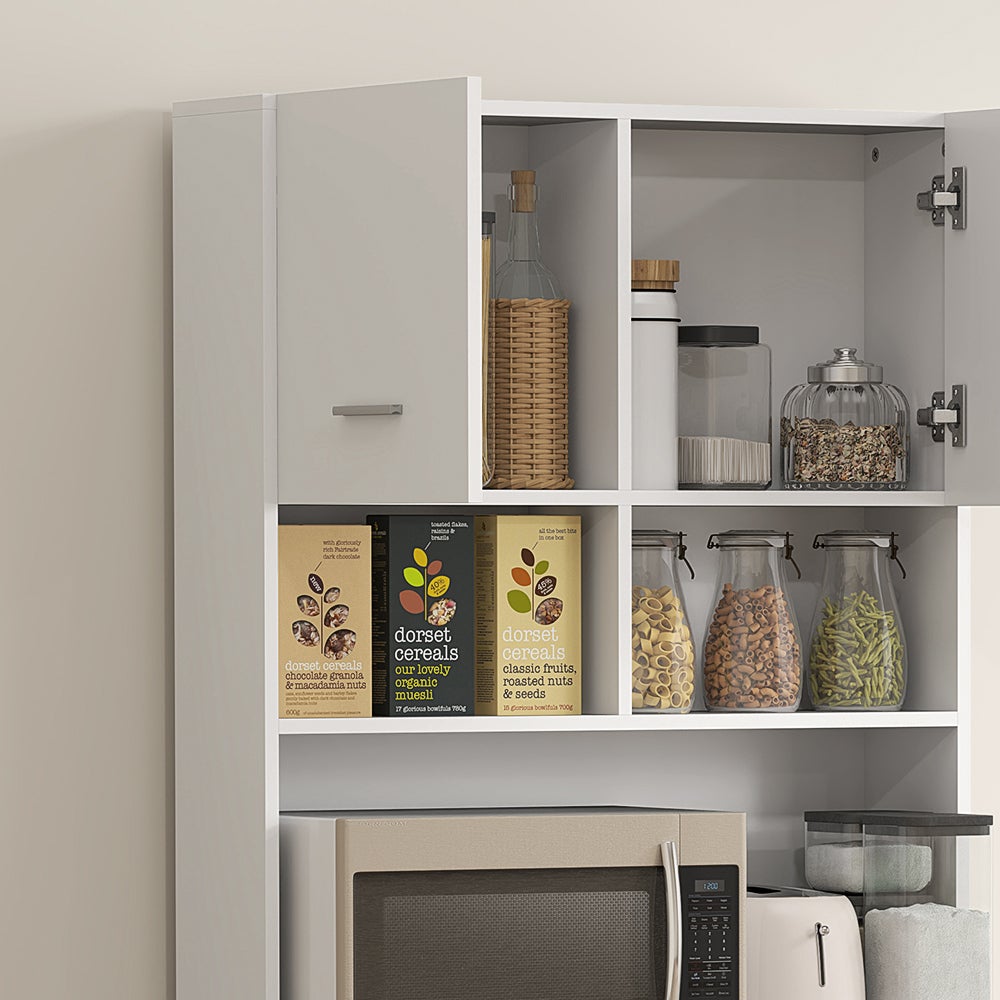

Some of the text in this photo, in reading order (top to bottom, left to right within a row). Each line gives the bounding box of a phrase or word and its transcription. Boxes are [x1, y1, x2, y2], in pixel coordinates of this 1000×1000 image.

[394, 626, 452, 643] dorset
[502, 625, 559, 642] dorset
[394, 644, 459, 661] cereals
[502, 643, 566, 660] cereals
[285, 660, 362, 671] dorset cereals
[395, 663, 451, 677] our lovely
[502, 662, 577, 676] classic fruits,
[285, 671, 364, 681] chocolate granola
[395, 676, 438, 689] organic
[502, 675, 573, 687] roasted nuts
[285, 680, 367, 690] & macadamia nuts
[394, 689, 434, 701] muesli
[502, 688, 546, 699] & seeds
